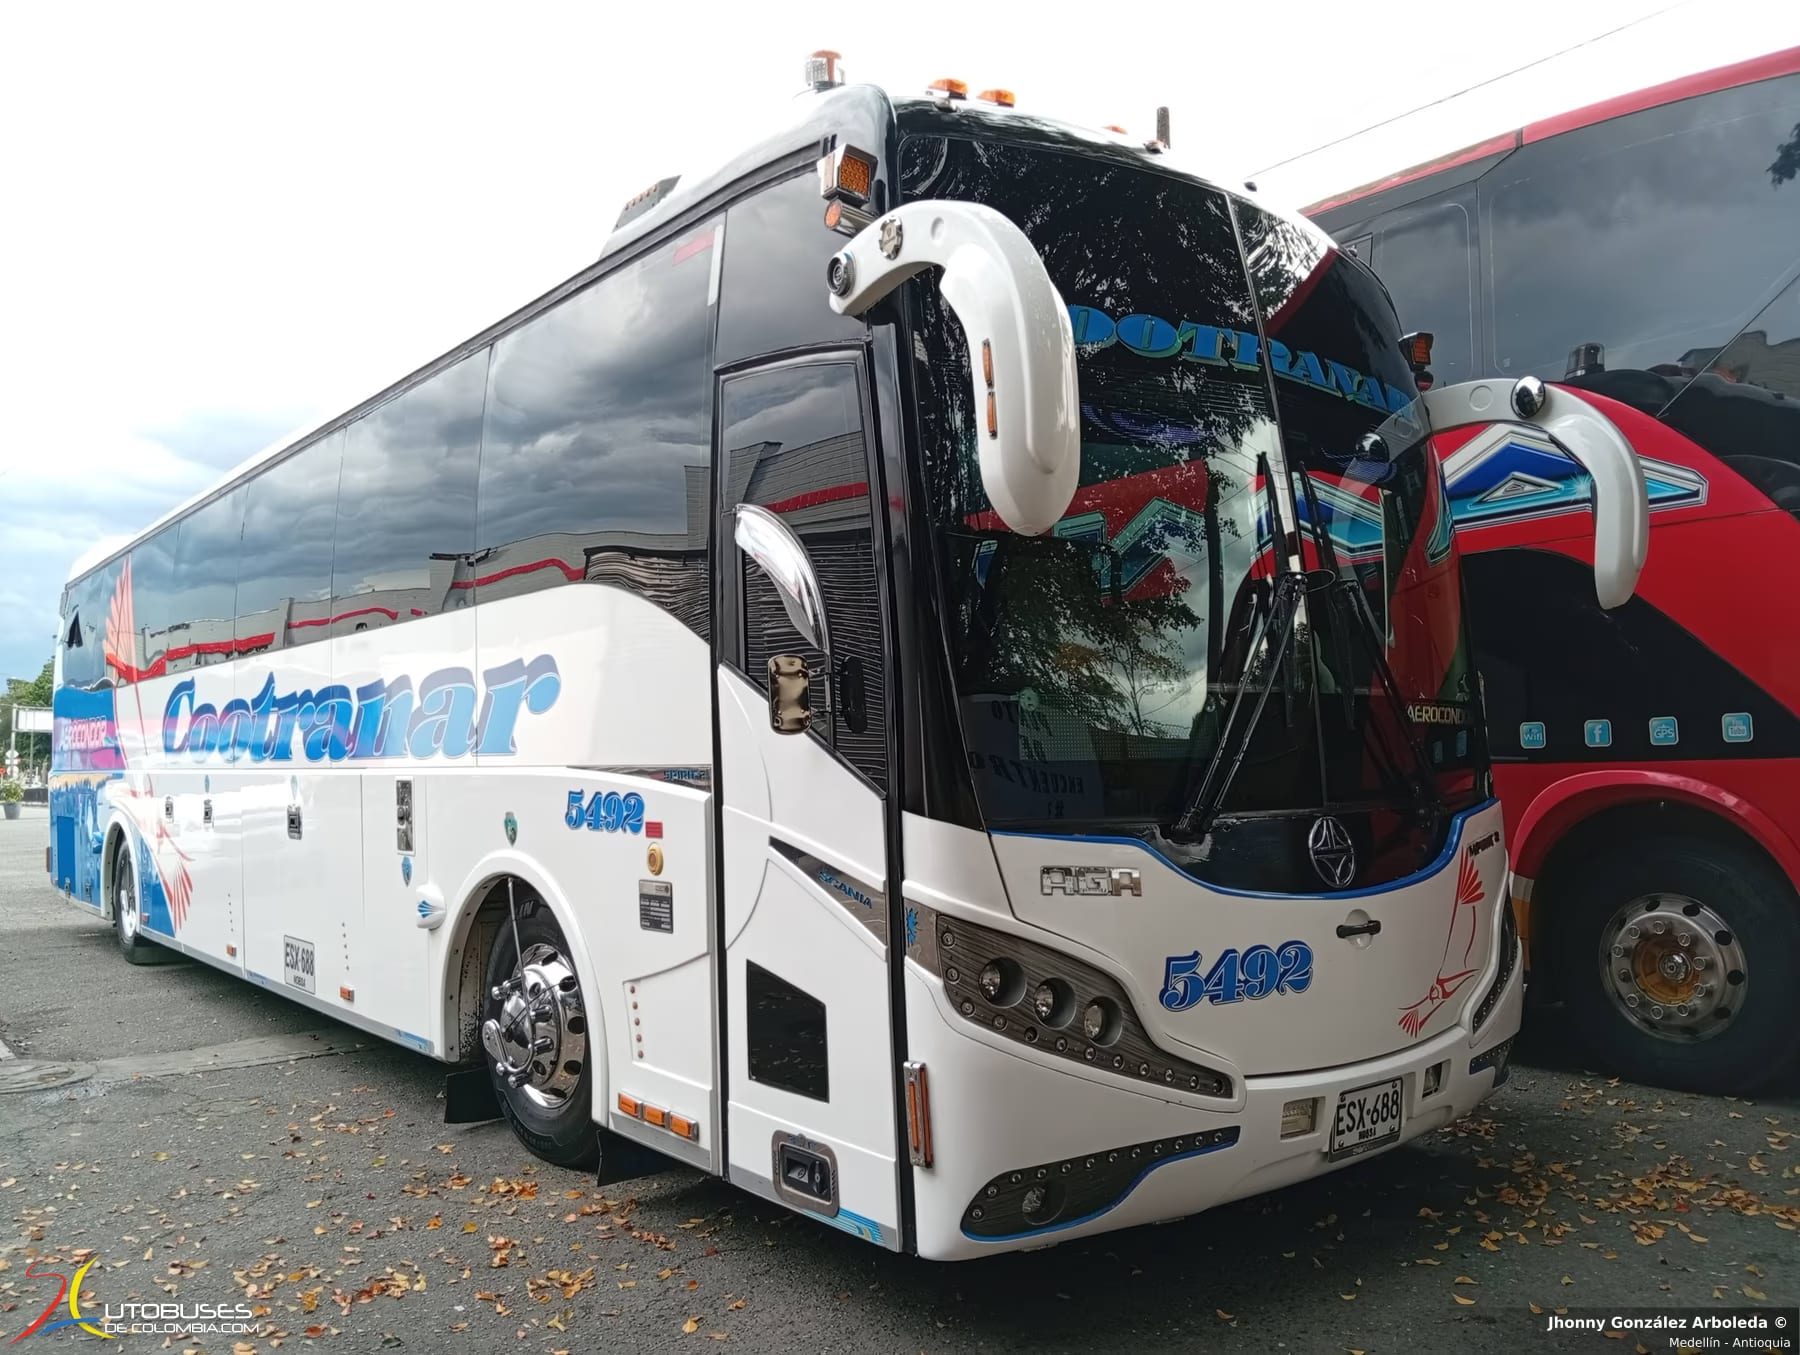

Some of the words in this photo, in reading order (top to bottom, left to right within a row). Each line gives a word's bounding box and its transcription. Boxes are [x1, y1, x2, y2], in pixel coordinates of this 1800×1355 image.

[1066, 304, 1422, 428] OOTRANAR
[162, 653, 562, 763] Cootranar
[1406, 704, 1470, 725] AEROCOND
[565, 788, 645, 835] 5492
[818, 869, 873, 909] SCANIA
[1158, 939, 1314, 1013] 5492
